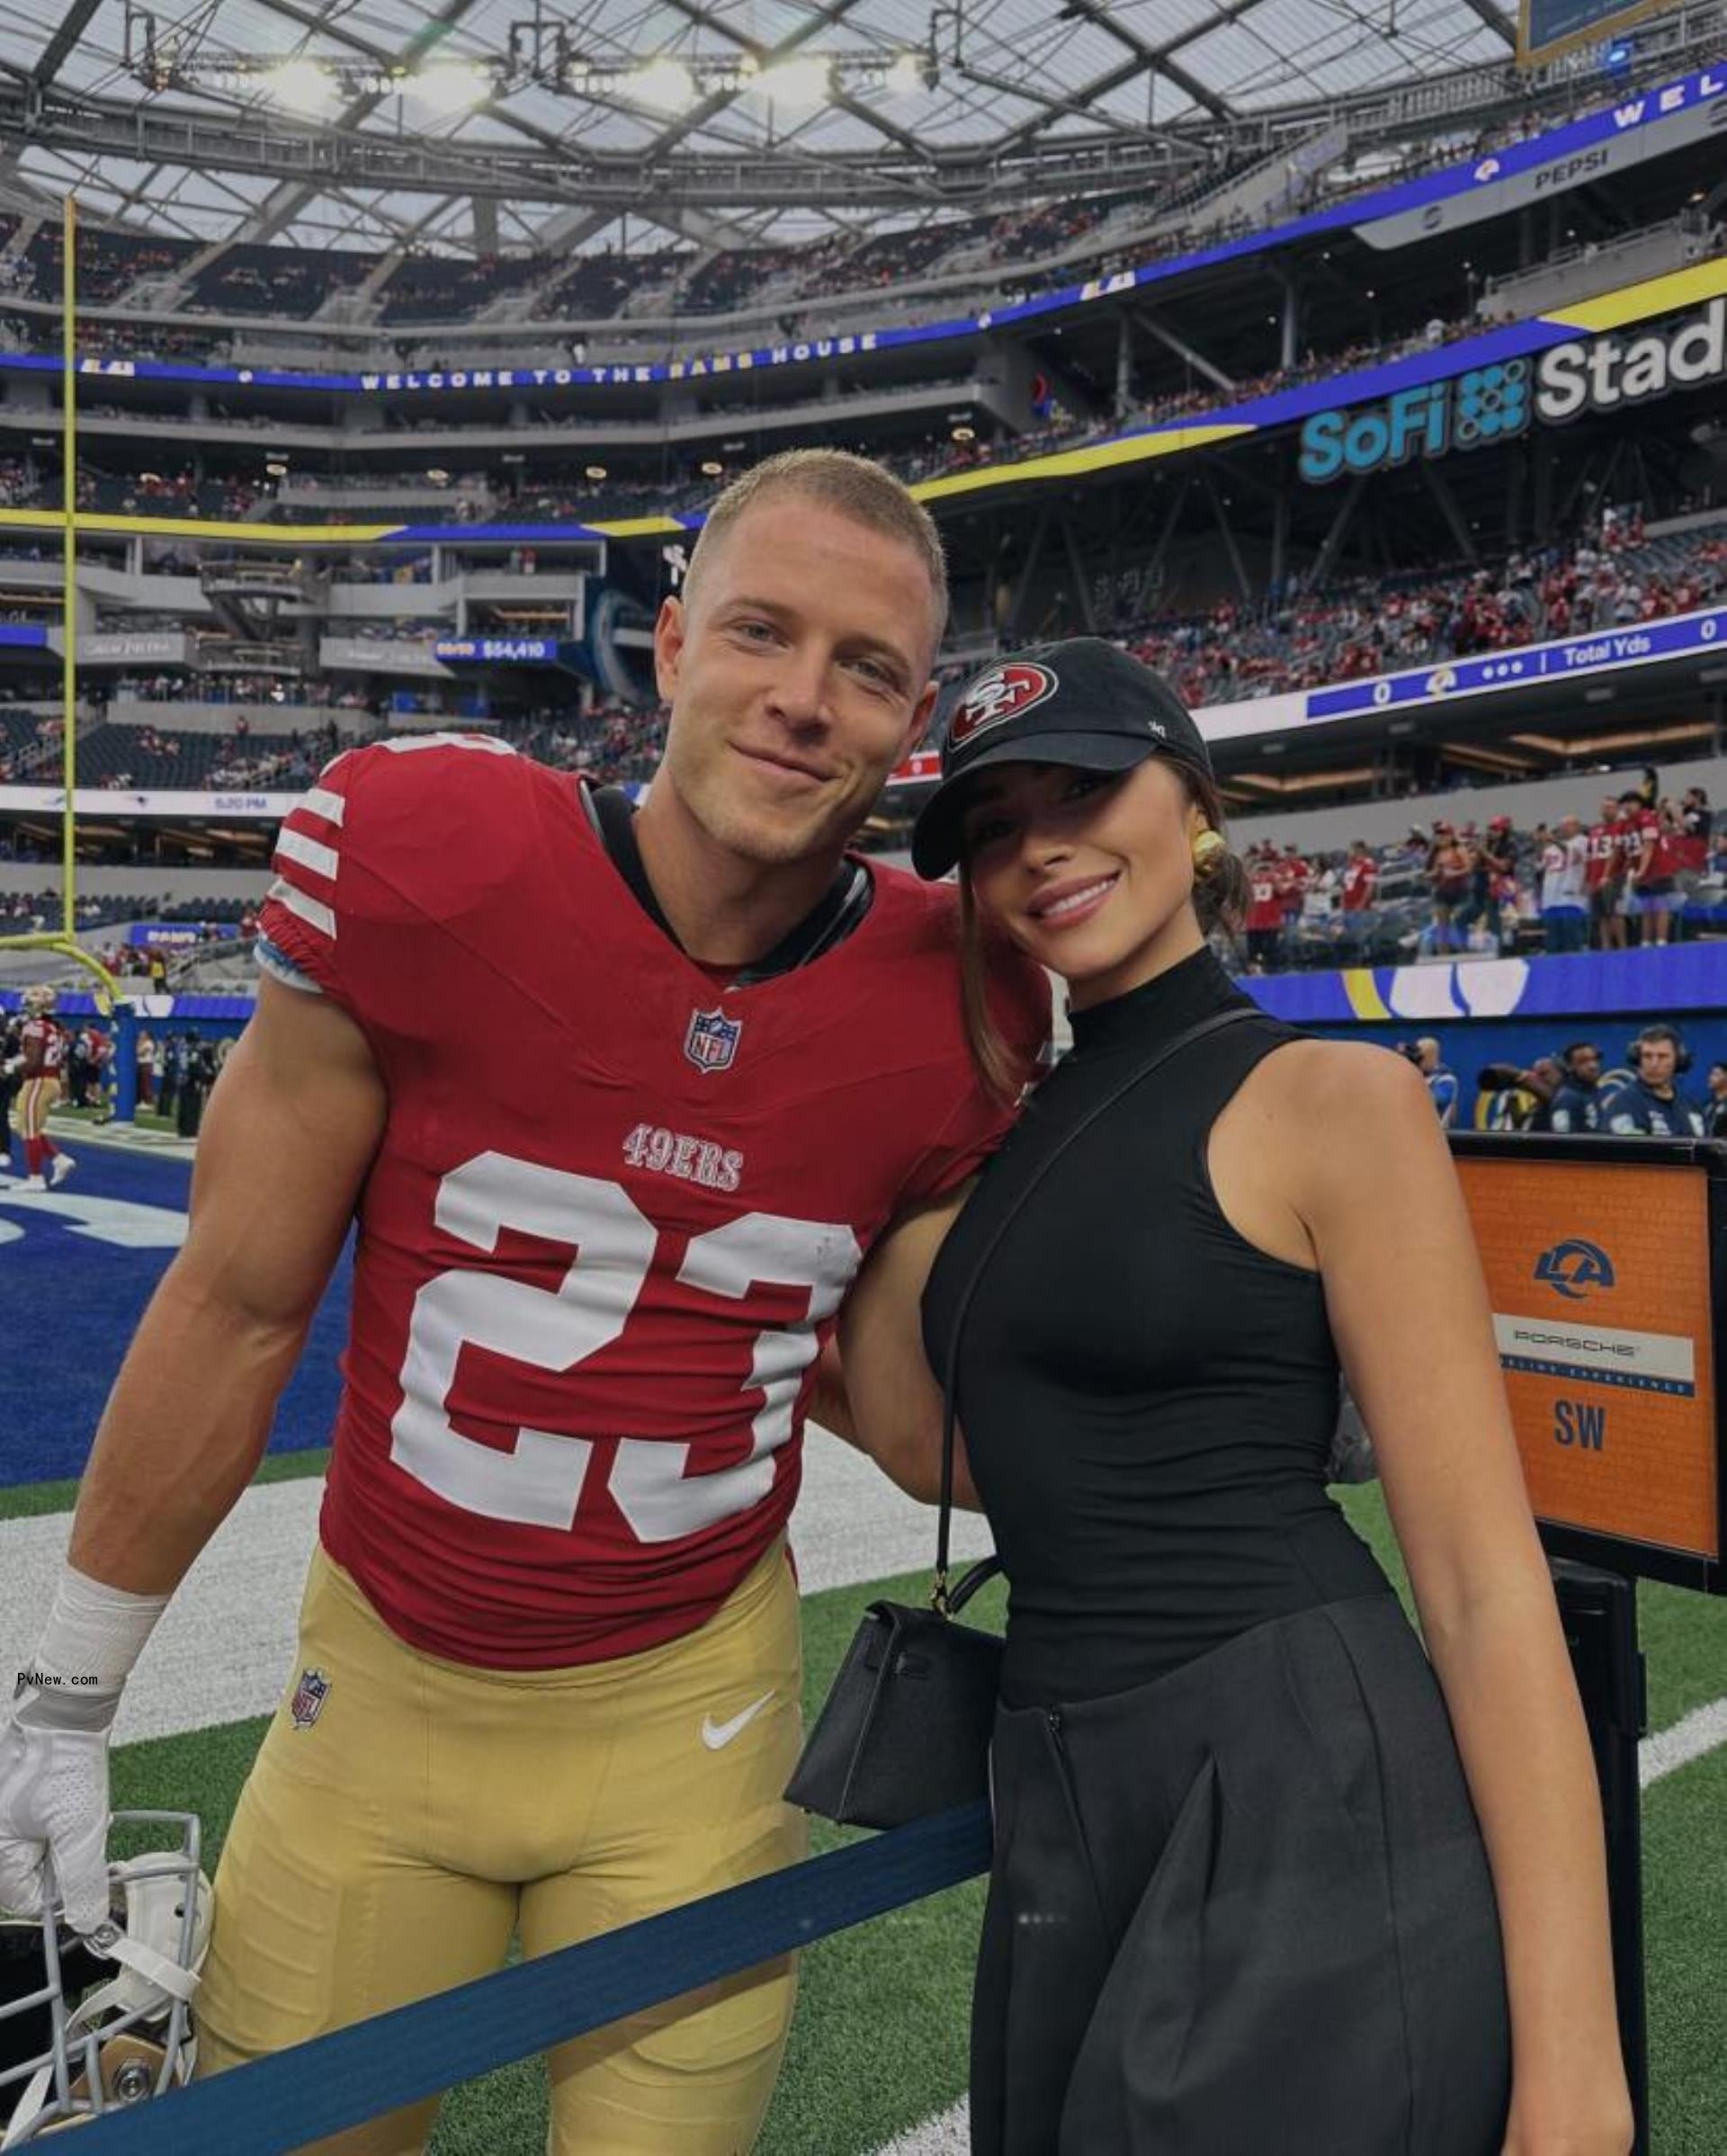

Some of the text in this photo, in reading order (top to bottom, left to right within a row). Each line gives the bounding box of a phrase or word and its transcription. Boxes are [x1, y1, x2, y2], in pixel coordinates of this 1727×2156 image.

[1535, 148, 1609, 189] PEPSI
[362, 370, 514, 389] WELCOME
[532, 370, 571, 384] TO
[592, 364, 651, 382] THE
[772, 334, 878, 364] HOUSE
[1300, 297, 1726, 479] SoFi Stad
[1563, 634, 1651, 667] Total Yds
[1701, 619, 1717, 640] 0
[622, 1123, 744, 1193] 49ERS
[389, 1150, 864, 1543] 23
[1514, 1329, 1635, 1357] PORSCHE
[1553, 1399, 1606, 1451] SW
